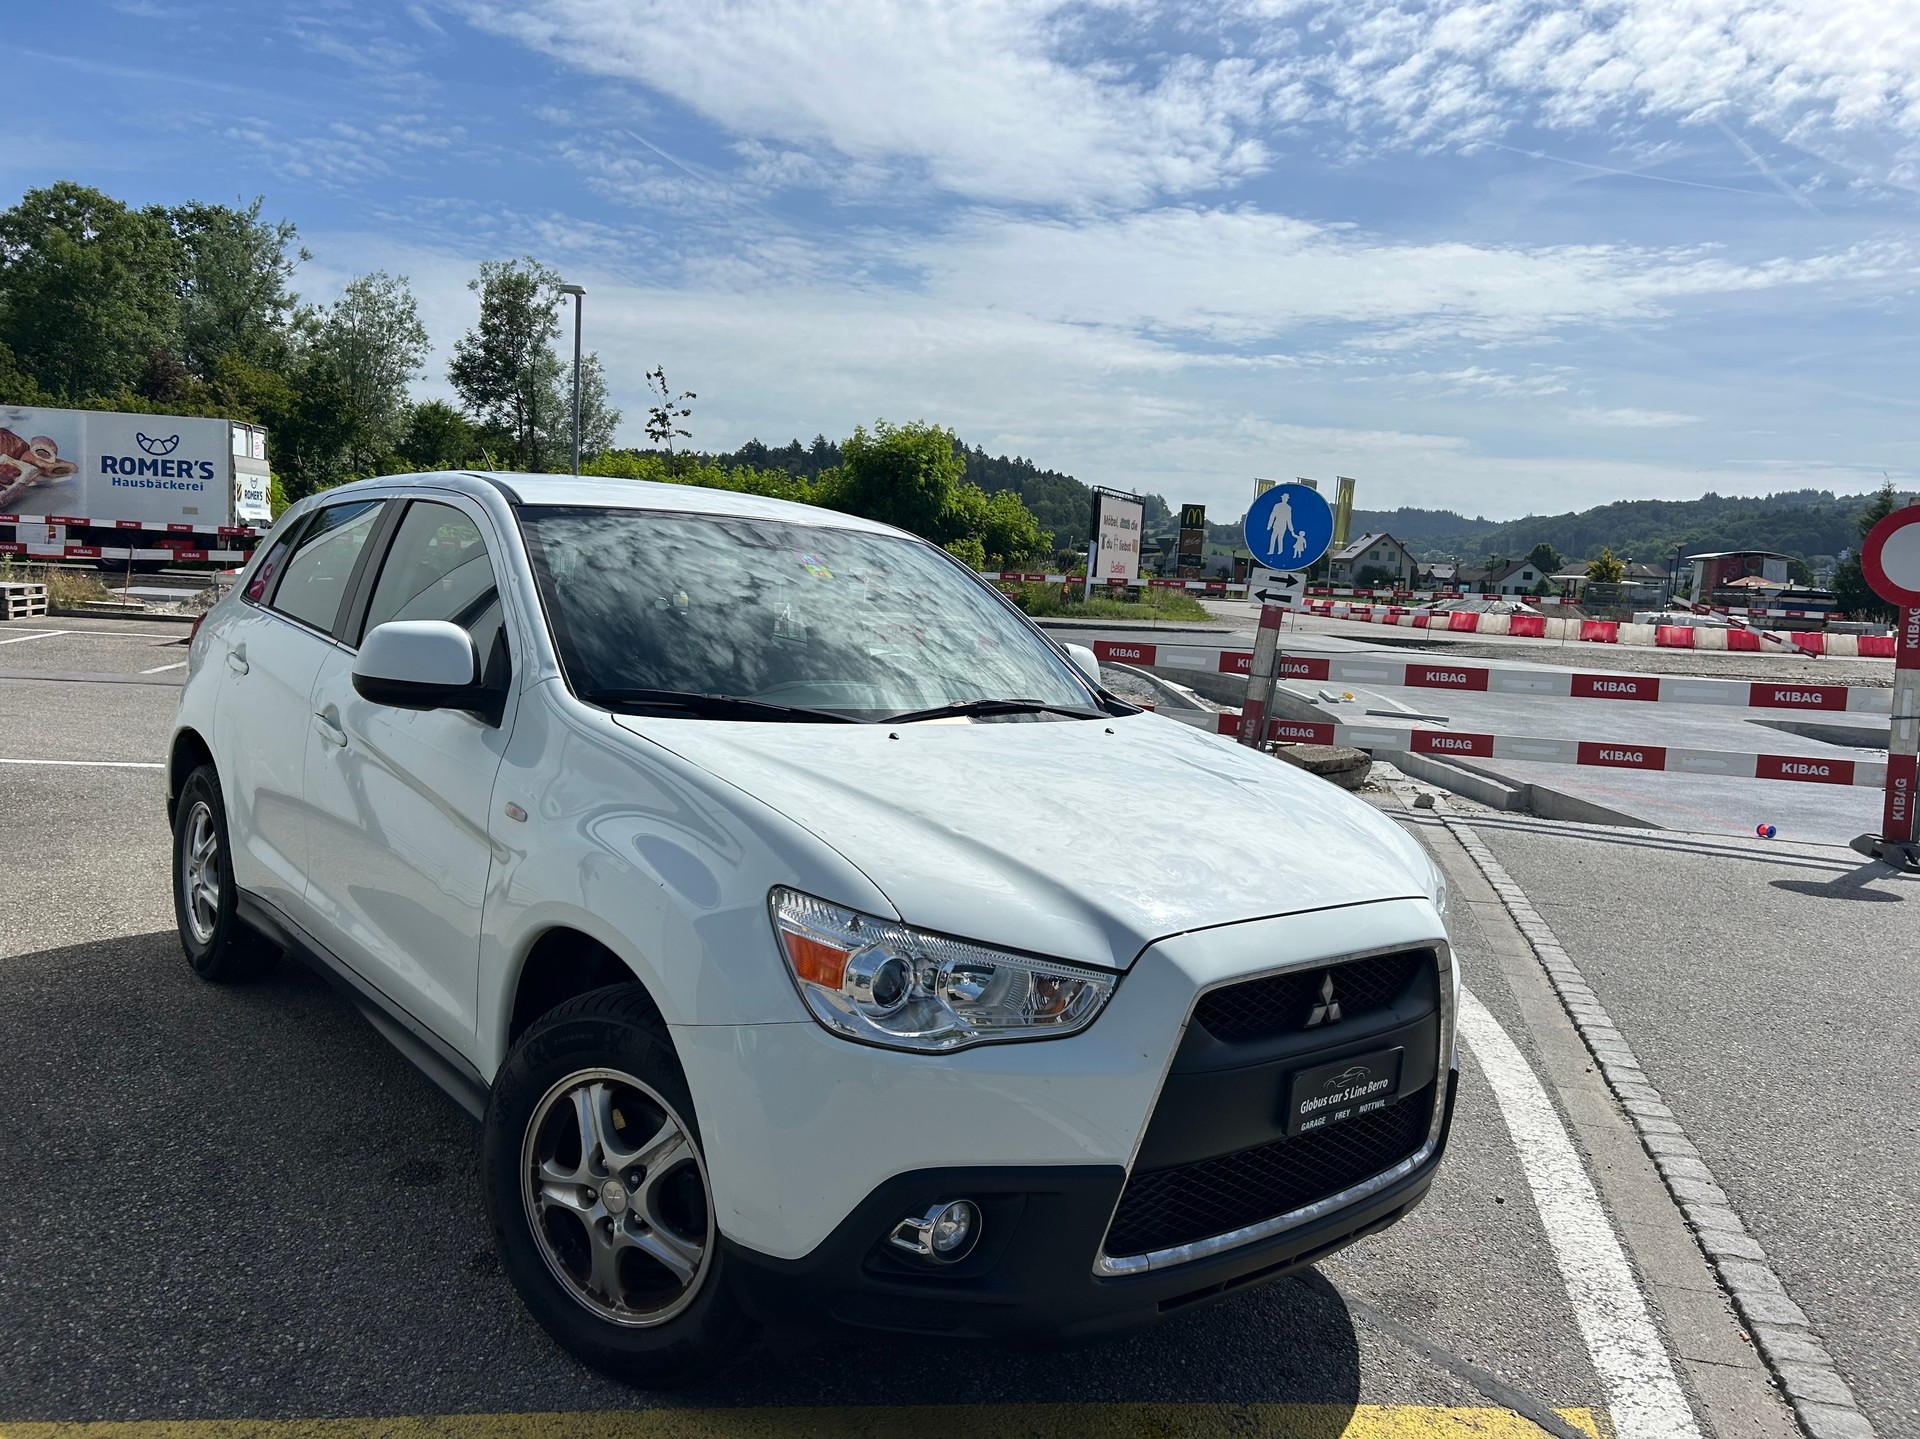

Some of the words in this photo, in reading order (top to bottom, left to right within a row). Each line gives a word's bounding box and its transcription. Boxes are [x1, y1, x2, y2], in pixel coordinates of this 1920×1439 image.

[101, 454, 214, 480] ROMER'S
[112, 478, 204, 491] Hausbäckerei
[1906, 608, 1920, 648] KIBAG
[1109, 648, 1140, 659] KIBAG
[1280, 664, 1309, 674] IBAG
[1425, 670, 1467, 685] KIBAG
[1592, 680, 1637, 694] KIBAG
[1774, 690, 1822, 704] KIBAG
[1278, 726, 1314, 738] KIBAG
[1431, 736, 1473, 751] KIBAG
[1599, 748, 1644, 763] KIBAG
[1781, 762, 1830, 777] KIBAG
[1892, 778, 1907, 821] KIBAG
[1300, 1096, 1328, 1114] Globus
[1328, 1093, 1343, 1104] car
[1344, 1088, 1350, 1100] S
[1350, 1085, 1366, 1099] Line
[1368, 1079, 1388, 1093] Berro
[1301, 1116, 1326, 1131] GARAGE
[1335, 1109, 1351, 1120] FREY
[1359, 1099, 1385, 1113] NOTTWIL
